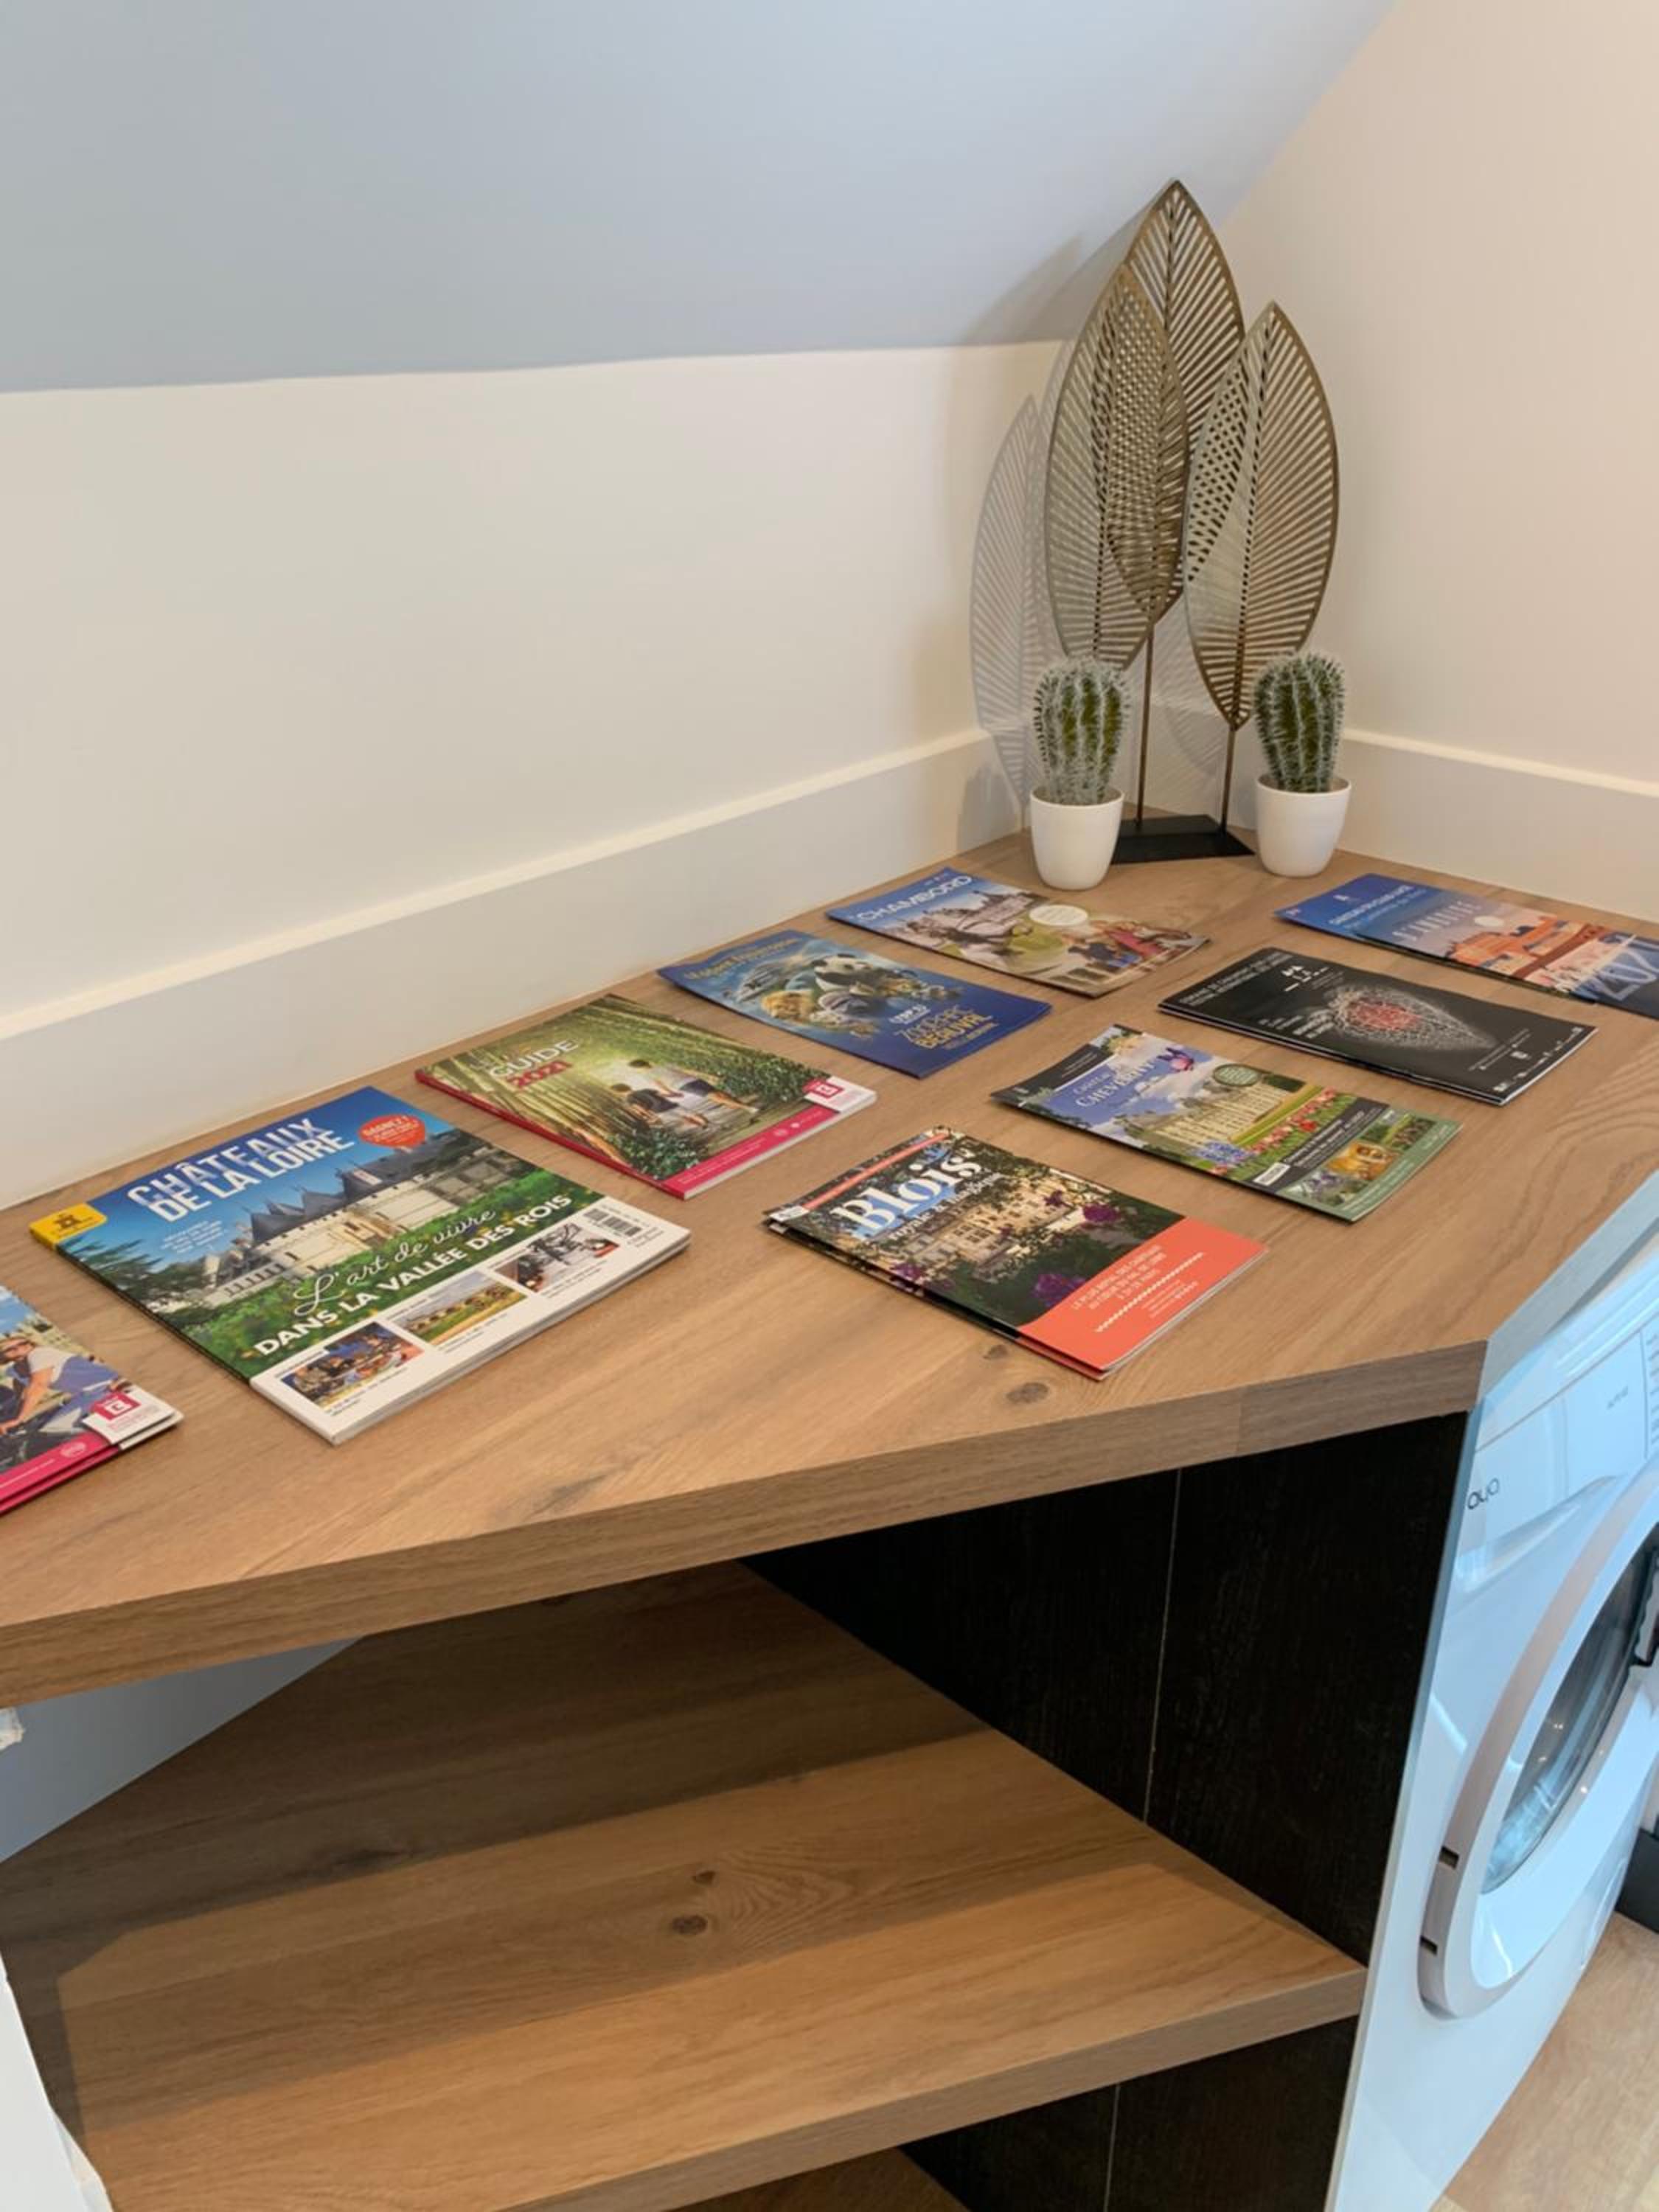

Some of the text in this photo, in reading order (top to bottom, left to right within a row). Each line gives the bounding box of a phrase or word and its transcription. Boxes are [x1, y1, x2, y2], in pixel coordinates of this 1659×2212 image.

[857, 875, 973, 920] CHAMBORD
[489, 1040, 579, 1077] GUIDE
[1075, 1060, 1155, 1107] CHEVERNY
[127, 1117, 326, 1207] CHÂTEAUX
[149, 1188, 212, 1222] DE
[201, 1171, 262, 1199] LA
[254, 1130, 355, 1179] LOIRE
[830, 1156, 981, 1231] Blois
[393, 1237, 429, 1263] de
[432, 1207, 497, 1245] vivre
[254, 1307, 338, 1357] DANS
[339, 1290, 381, 1314] LA
[377, 1246, 467, 1293] VALLÉE
[465, 1224, 516, 1252] DES
[515, 1192, 574, 1228] ROIS
